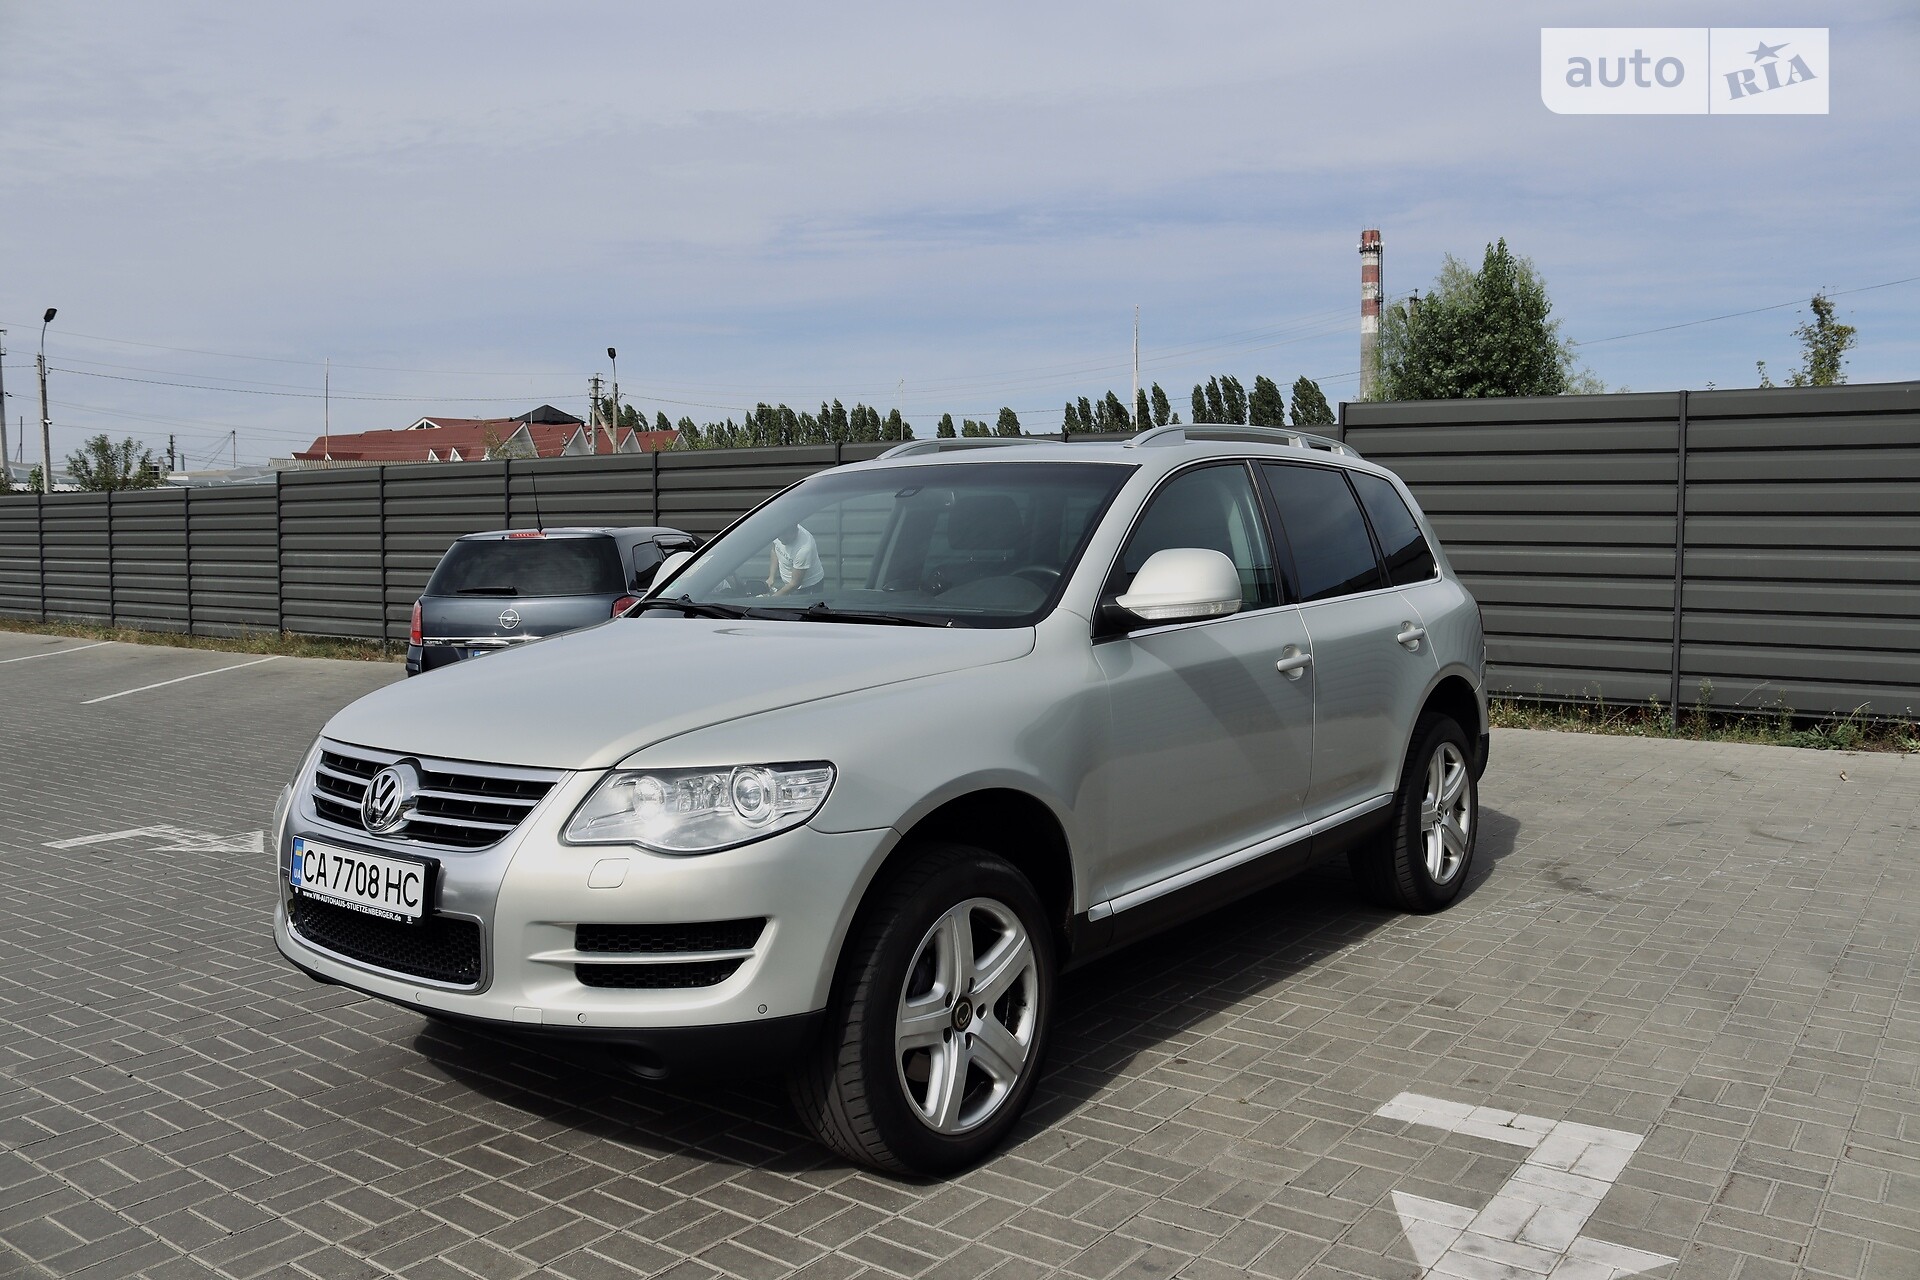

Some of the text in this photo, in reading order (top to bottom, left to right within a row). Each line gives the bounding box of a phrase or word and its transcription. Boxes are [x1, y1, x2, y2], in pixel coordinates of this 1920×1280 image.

[303, 849, 420, 908] CA 7708 HC
